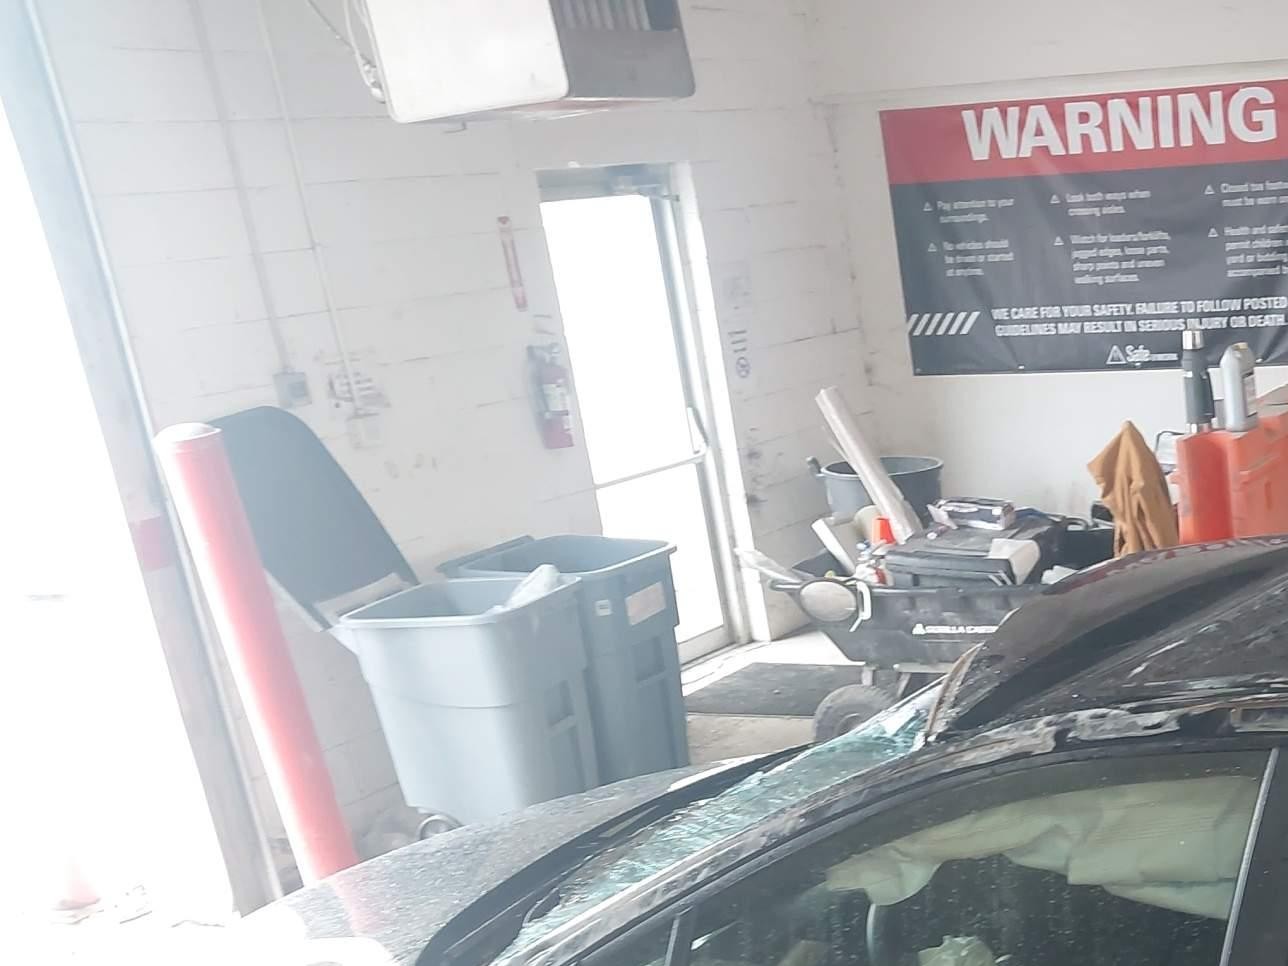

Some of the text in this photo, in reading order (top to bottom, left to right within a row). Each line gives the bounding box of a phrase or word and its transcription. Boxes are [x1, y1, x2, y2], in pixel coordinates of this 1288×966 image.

[961, 87, 1277, 161] WARNING
[991, 307, 1010, 320] WE
[1010, 306, 1040, 320] CARE
[1040, 305, 1061, 318] FOR
[1062, 304, 1092, 318] YOUR
[1135, 301, 1179, 315] FAILURE
[1180, 301, 1196, 314] TO
[1196, 299, 1242, 313] FOLLOW
[1243, 296, 1288, 310] POSTED
[995, 323, 1057, 337] GUIDELINES
[1057, 322, 1082, 335] MAY
[1083, 320, 1122, 334] RESULT
[1123, 320, 1137, 332] IN
[1138, 318, 1186, 332] SERIOUS
[1186, 316, 1229, 330] INJURY
[1230, 315, 1247, 328] OR
